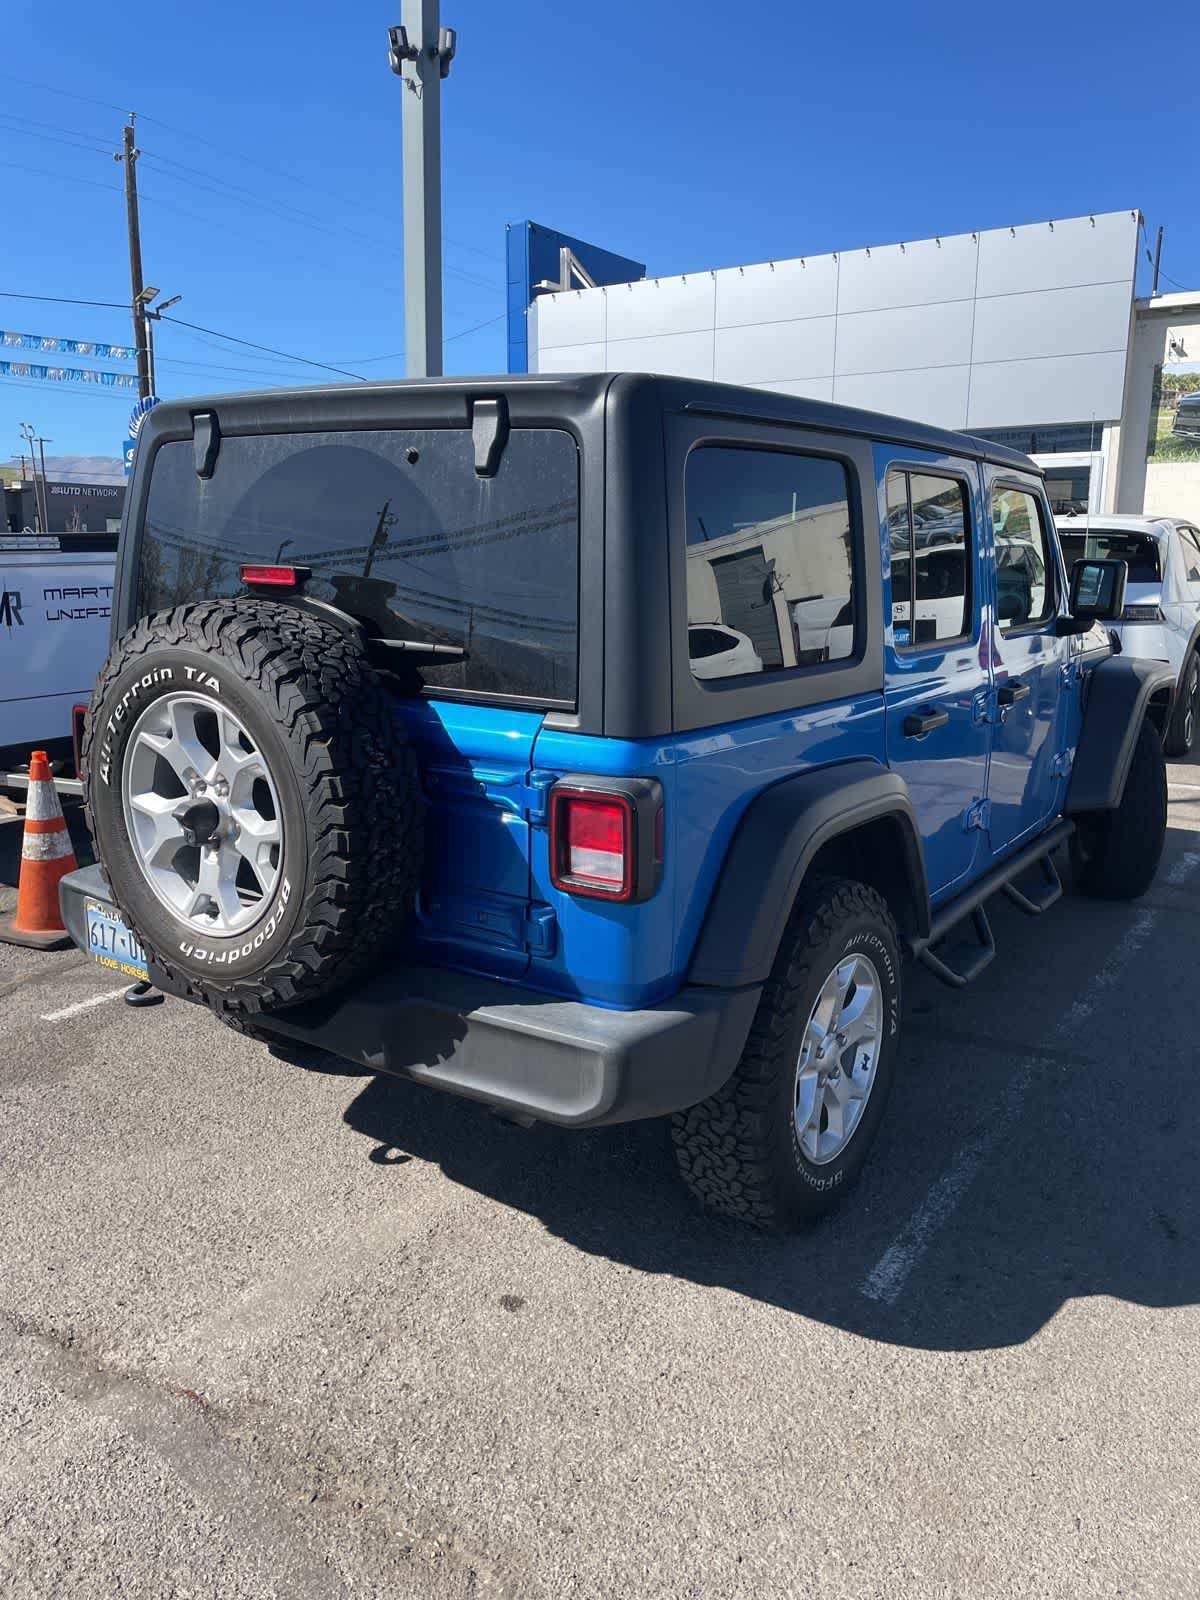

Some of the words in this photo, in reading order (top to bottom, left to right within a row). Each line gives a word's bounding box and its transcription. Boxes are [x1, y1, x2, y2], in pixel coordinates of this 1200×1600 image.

[82, 487, 118, 497] NETWORK
[100, 667, 173, 785] All-Terrain
[184, 666, 220, 693] T/A
[179, 878, 291, 964] BFGoodrich
